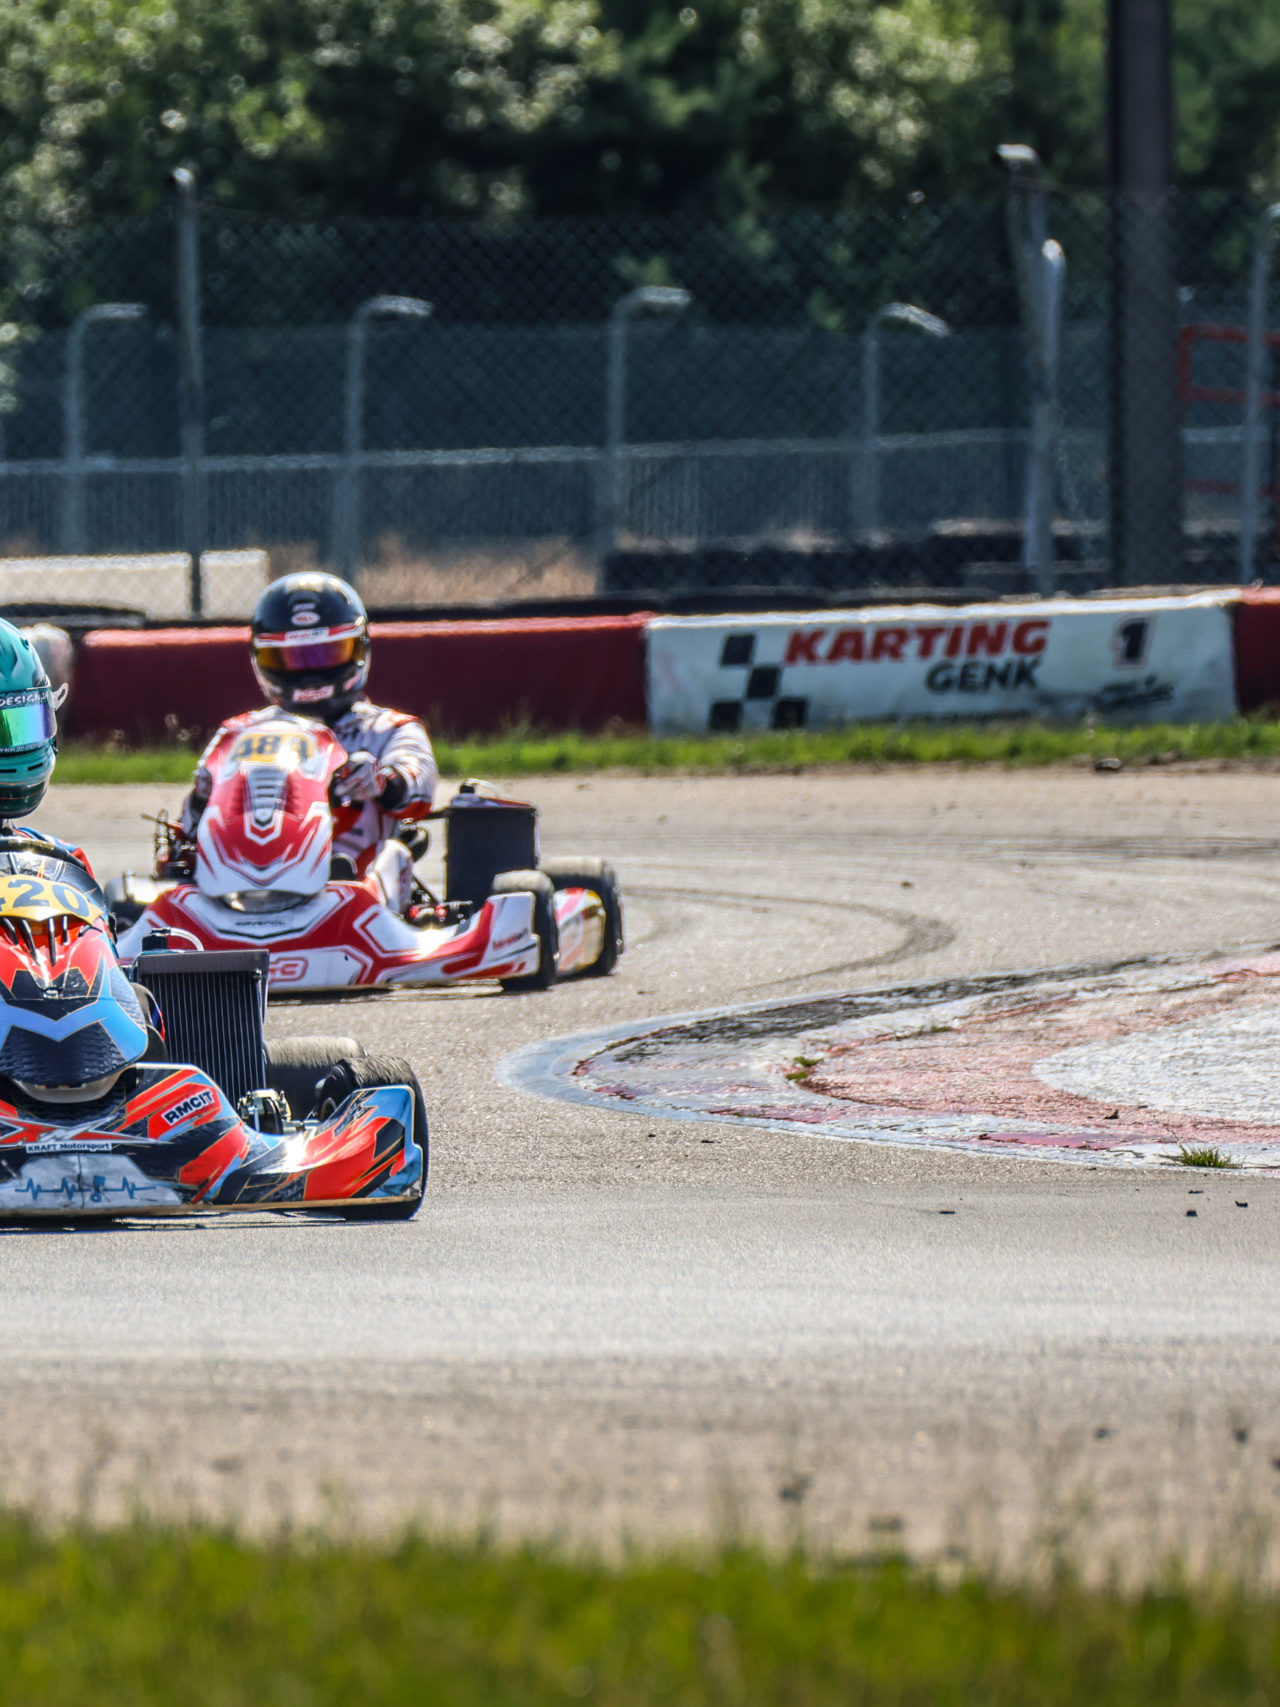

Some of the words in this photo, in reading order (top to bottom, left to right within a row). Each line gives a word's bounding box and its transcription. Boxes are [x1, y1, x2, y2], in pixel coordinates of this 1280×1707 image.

[785, 621, 1050, 663] KARTING
[1113, 615, 1155, 670] 1
[925, 657, 1040, 692] GENK
[162, 1089, 214, 1125] RMCIT
[28, 1143, 57, 1152] KRAFT
[60, 1142, 110, 1151] Motorsport
